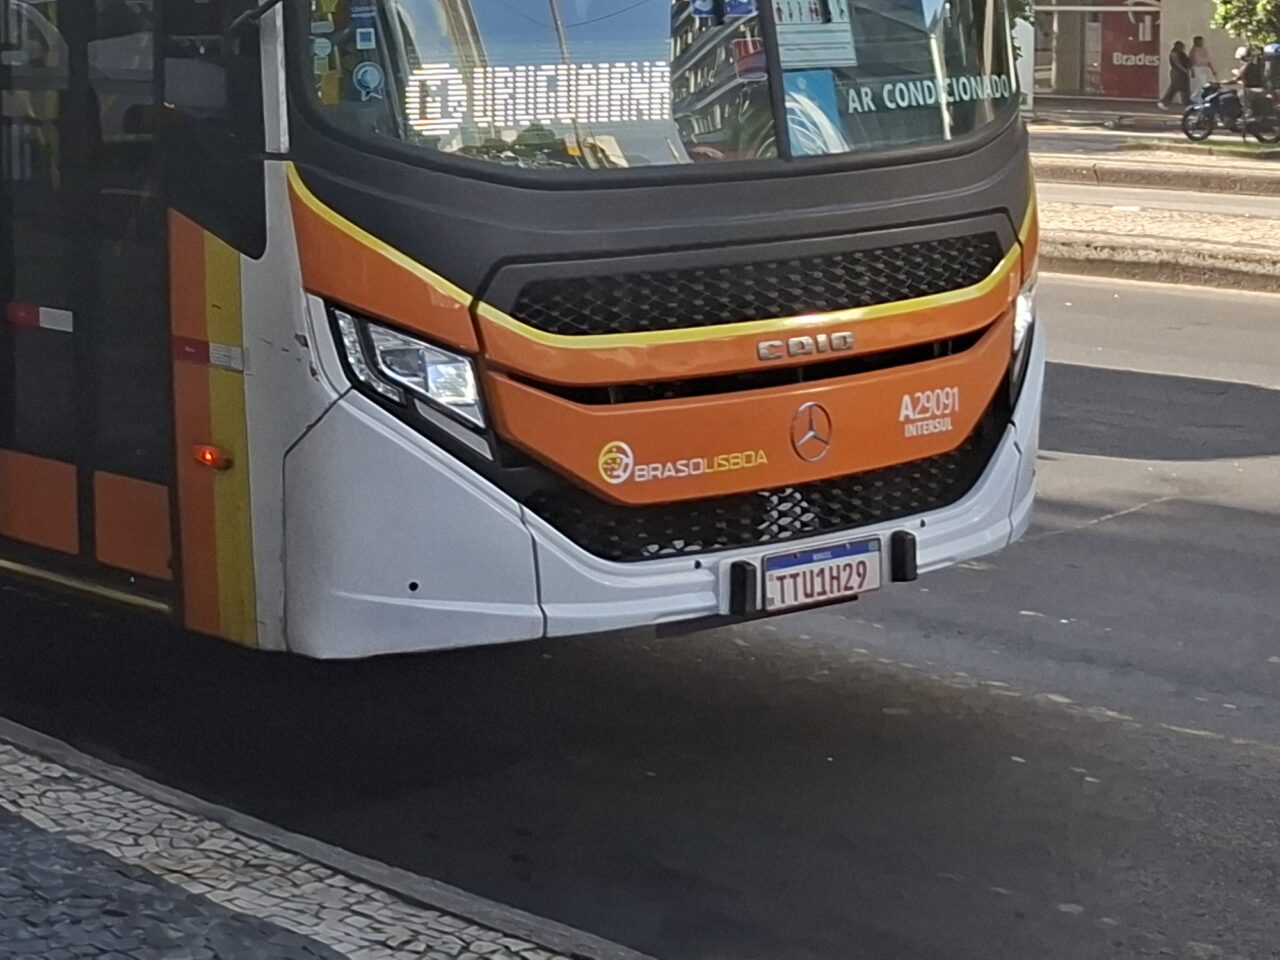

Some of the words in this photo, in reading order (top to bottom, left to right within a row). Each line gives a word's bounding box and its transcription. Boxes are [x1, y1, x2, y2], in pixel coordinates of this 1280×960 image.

[848, 87, 876, 113] AR
[898, 386, 960, 423] A29091
[904, 417, 953, 437] INTERSUL
[634, 448, 768, 482] BRASOLISBOA
[775, 560, 868, 604] TTU1H29
